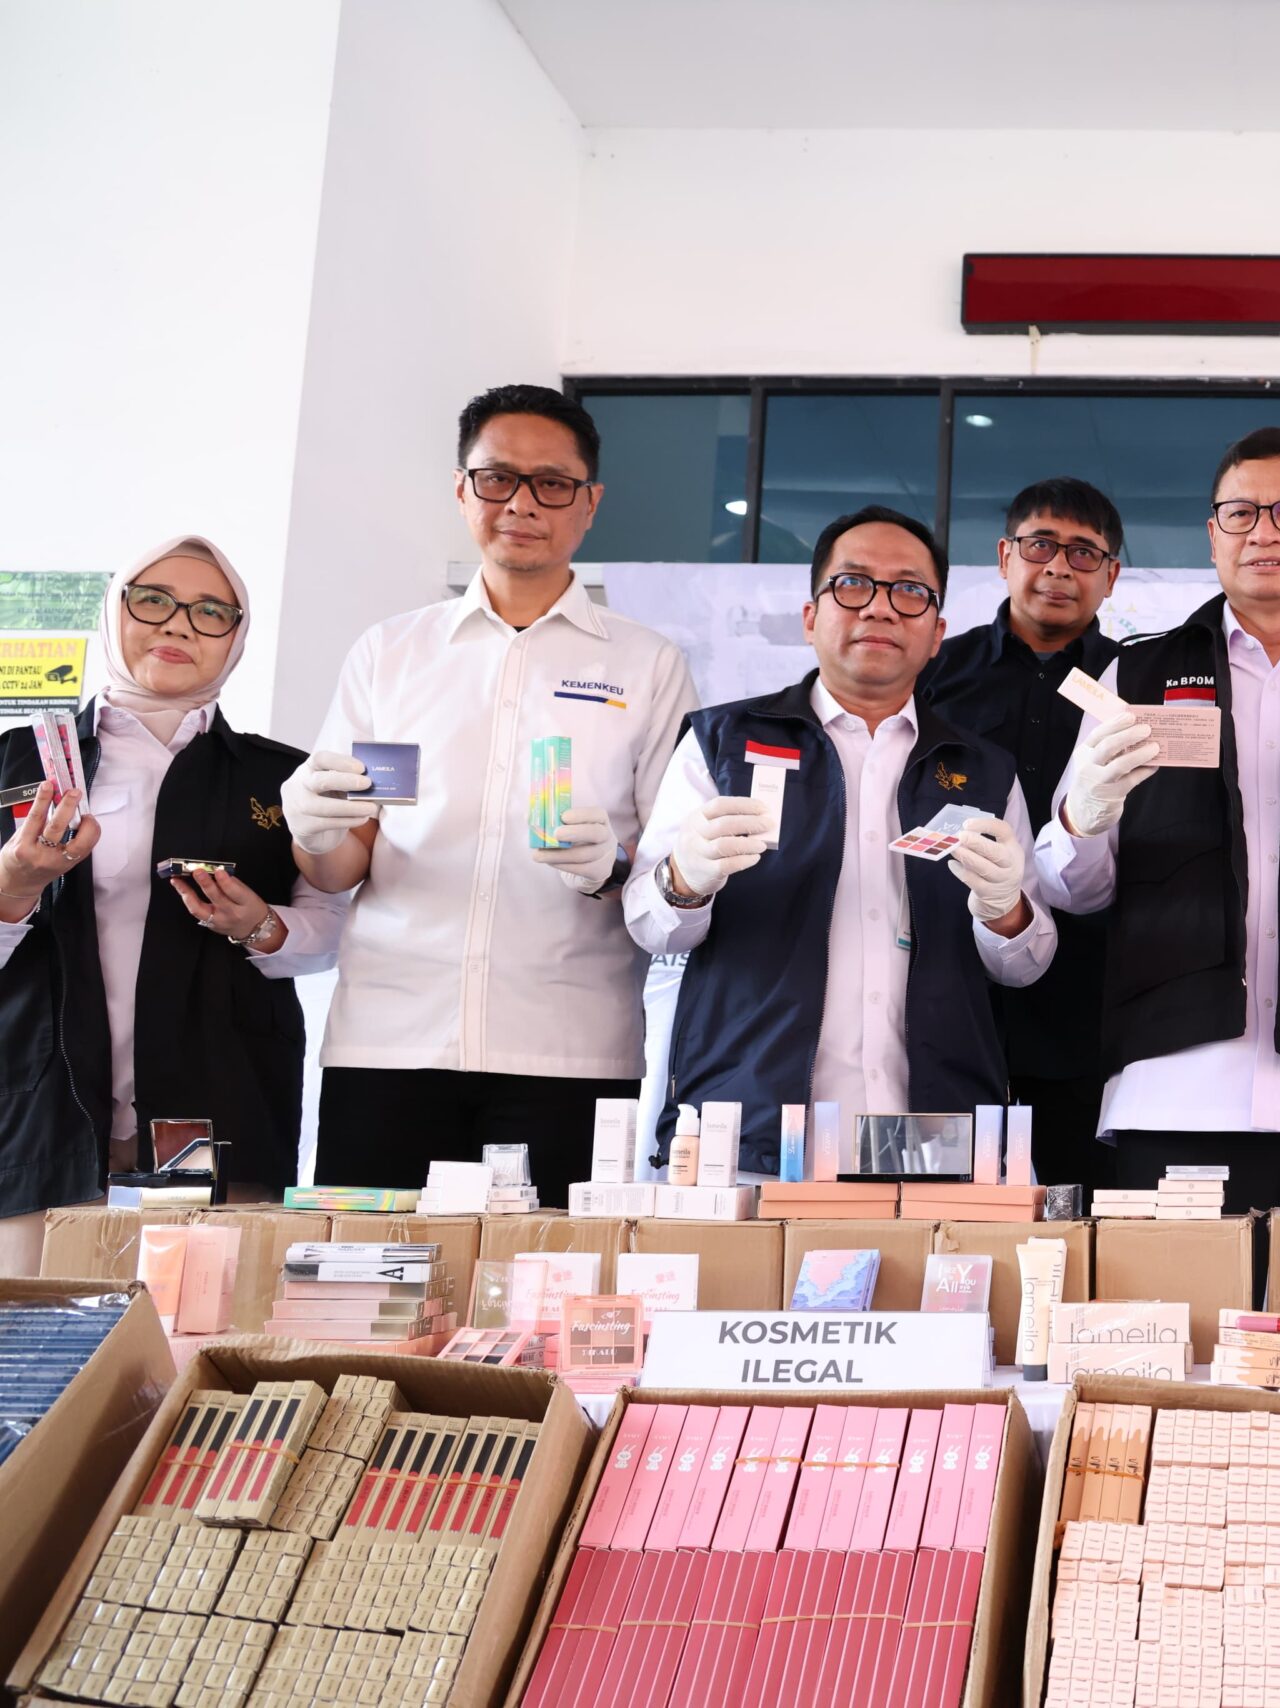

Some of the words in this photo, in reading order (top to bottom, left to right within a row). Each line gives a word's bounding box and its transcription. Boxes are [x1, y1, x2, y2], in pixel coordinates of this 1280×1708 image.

[0, 642, 78, 658] RHATIAN
[561, 679, 624, 696] KEMENKEU
[1166, 679, 1178, 688] Ka
[1180, 676, 1215, 686] BPOM
[1023, 1277, 1039, 1352] lameila
[718, 1320, 898, 1346] KOSMETIK
[1070, 1322, 1178, 1343] lameila
[740, 1359, 865, 1385] ILEGAL
